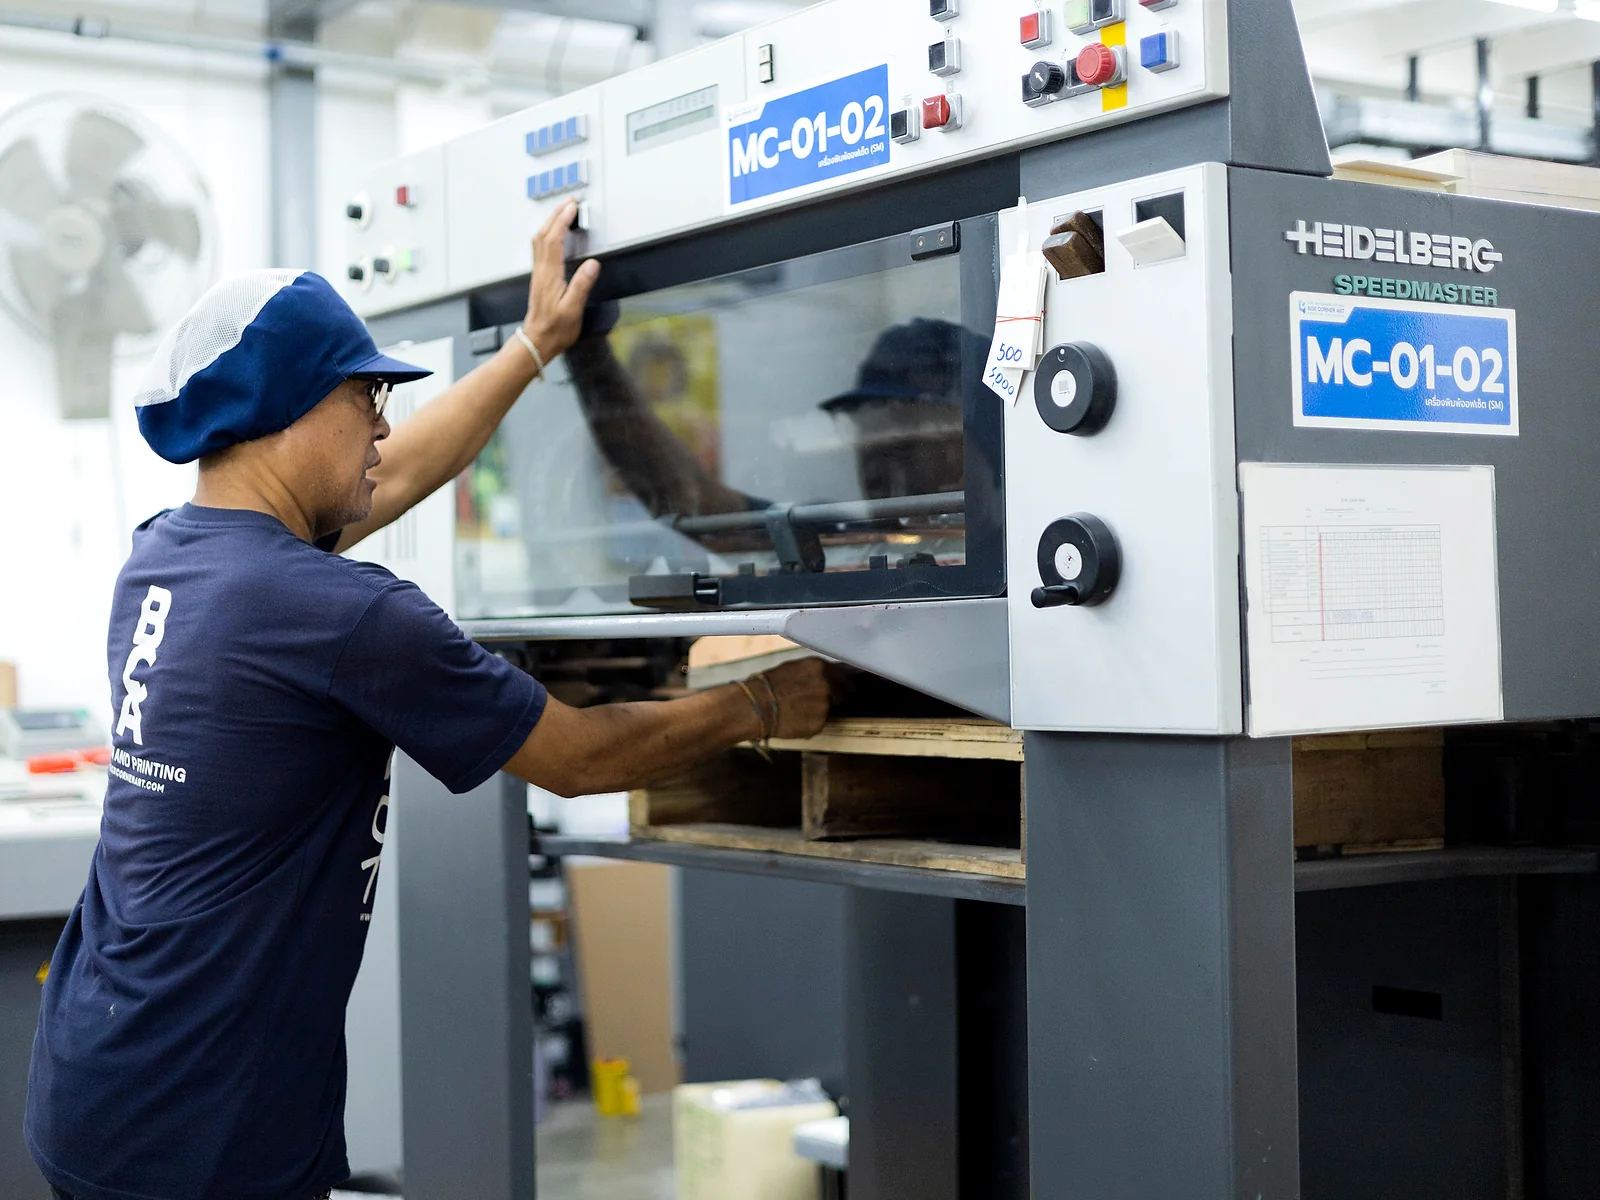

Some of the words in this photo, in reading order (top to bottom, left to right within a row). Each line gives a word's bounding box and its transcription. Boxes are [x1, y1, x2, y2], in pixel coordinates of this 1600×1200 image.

[732, 94, 886, 178] MC-01-02
[1285, 220, 1502, 273] HEIDELBERG
[1334, 274, 1498, 306] SPEEDMASTER
[997, 343, 1022, 361] 500
[1307, 336, 1505, 394] MC-01-02
[1488, 399, 1504, 411] (SM)
[114, 747, 130, 768] AND
[131, 755, 187, 783] PRINTING
